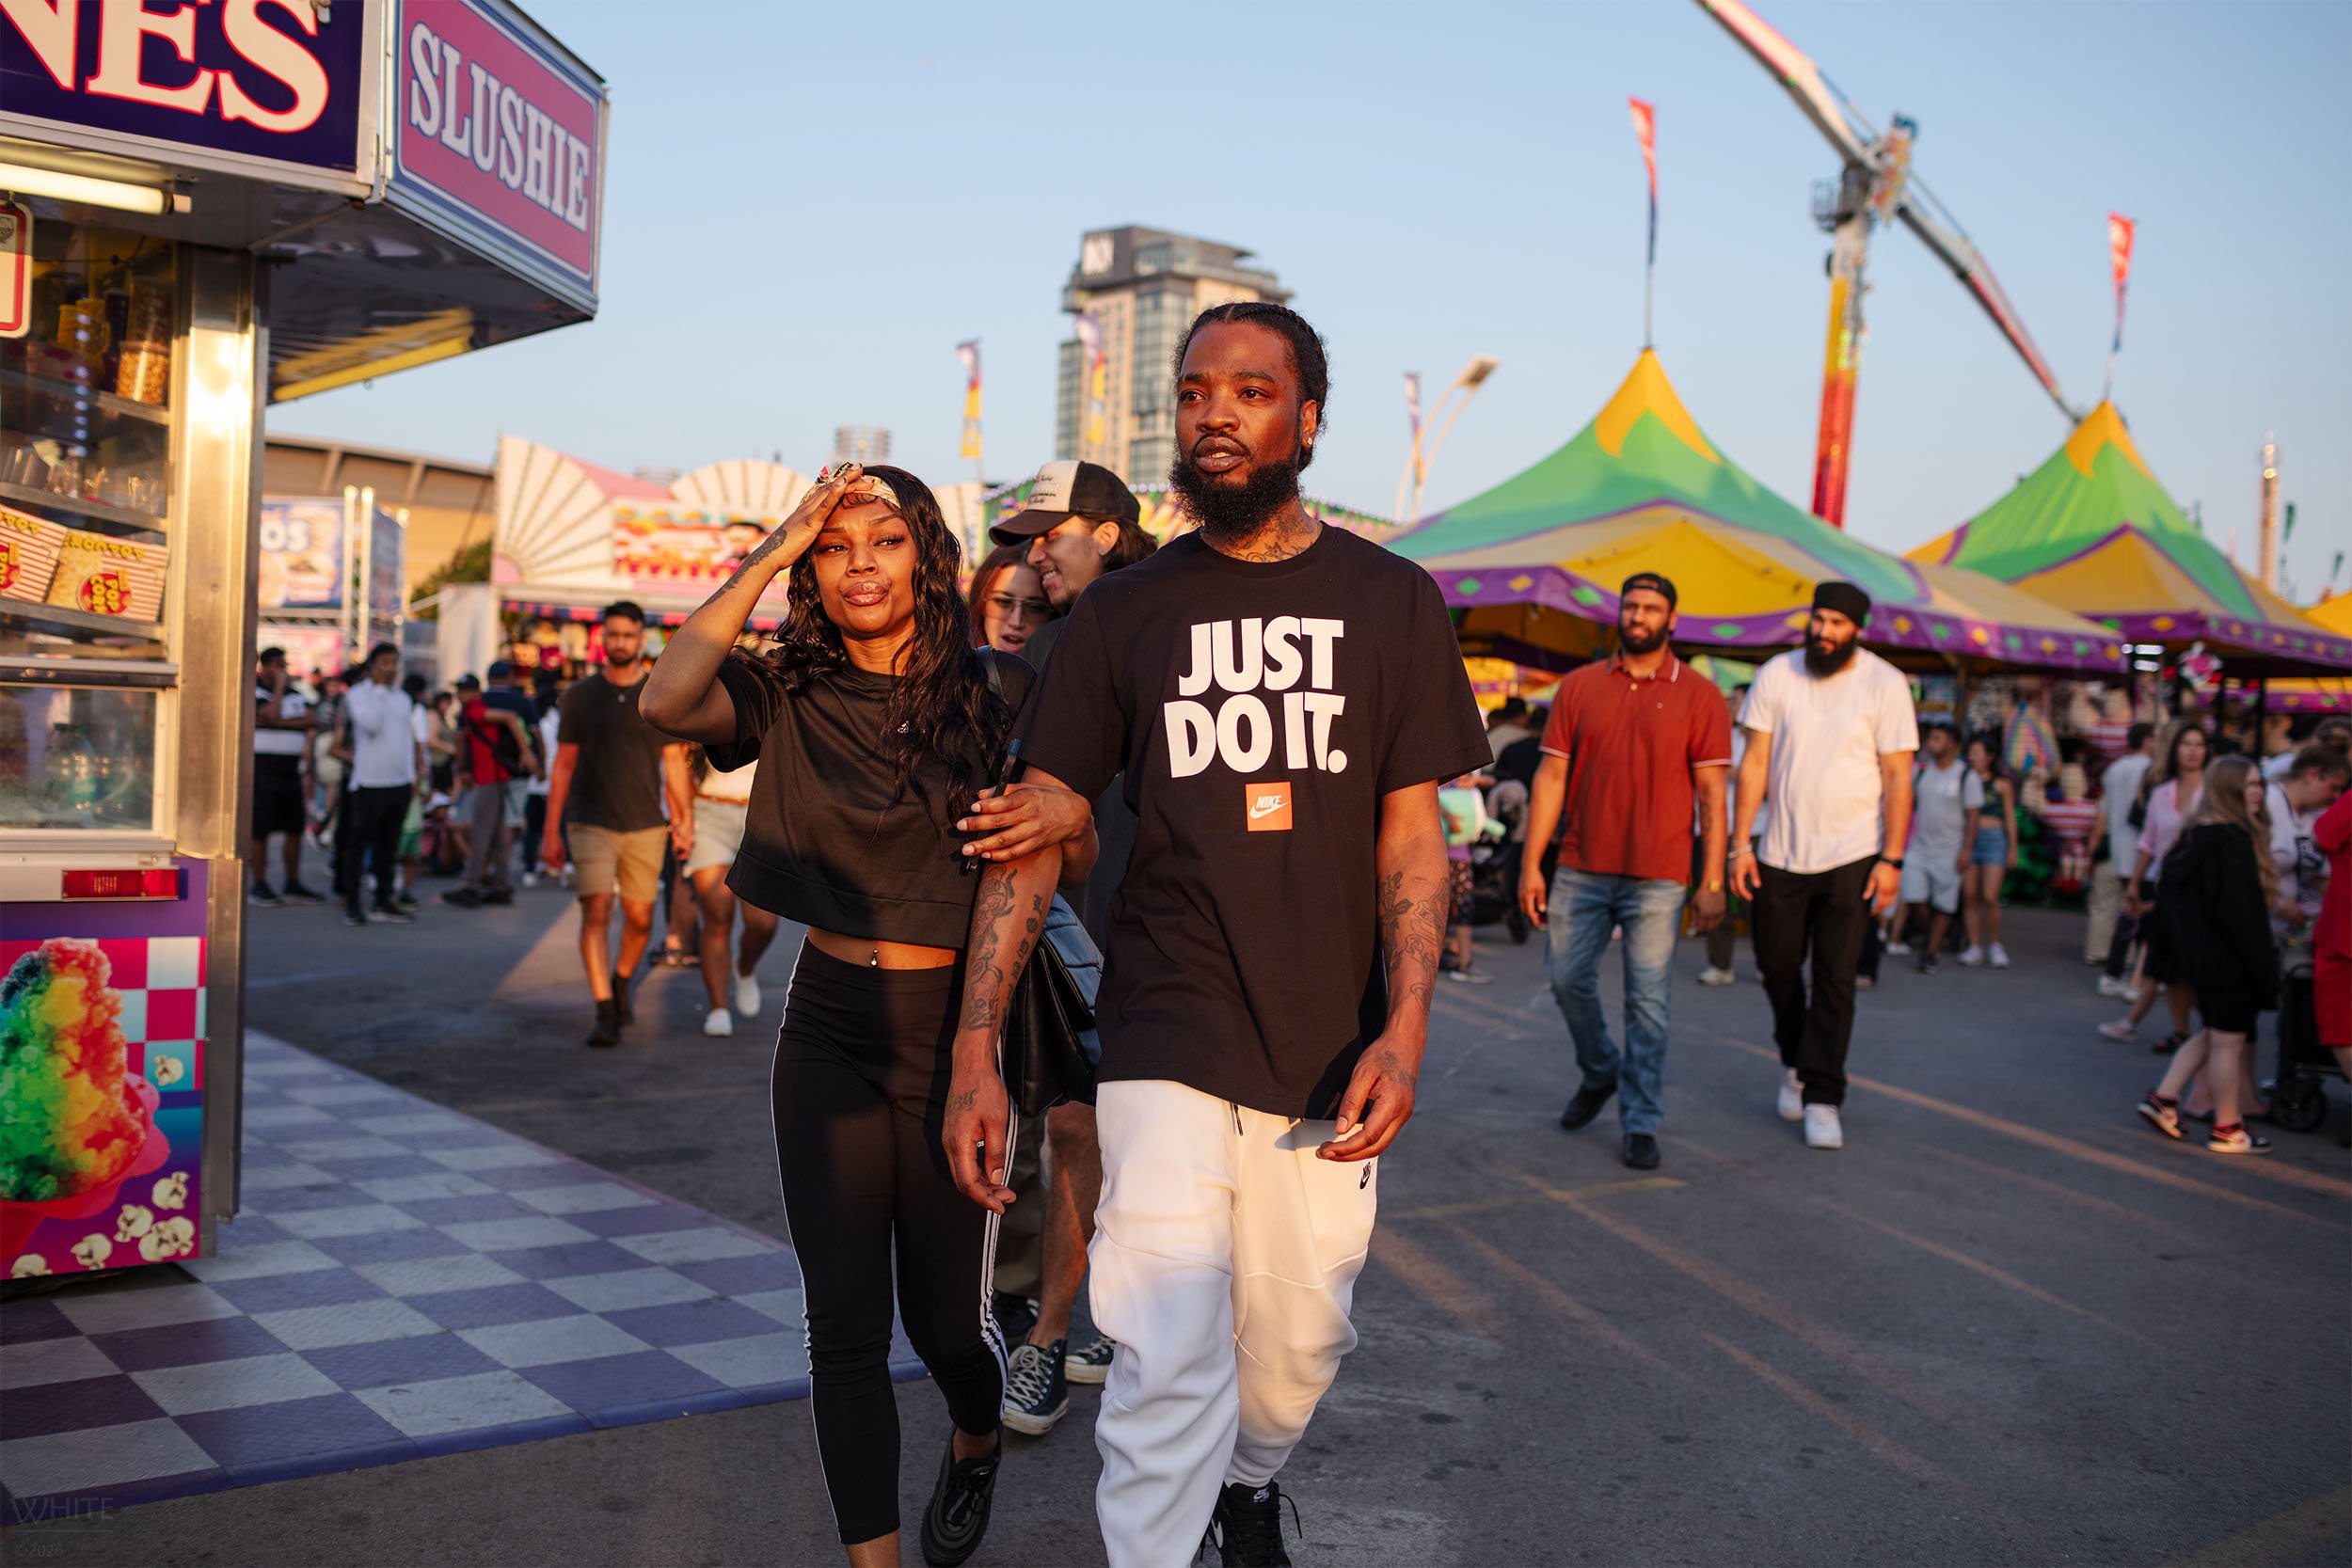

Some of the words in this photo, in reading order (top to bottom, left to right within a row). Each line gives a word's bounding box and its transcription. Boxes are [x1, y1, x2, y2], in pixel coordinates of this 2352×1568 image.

[409, 21, 590, 233] SLUSHIE
[1178, 616, 1344, 696] JUST
[1164, 693, 1273, 778] DO
[1283, 691, 1348, 774] IT.
[1256, 795, 1282, 809] NIKE
